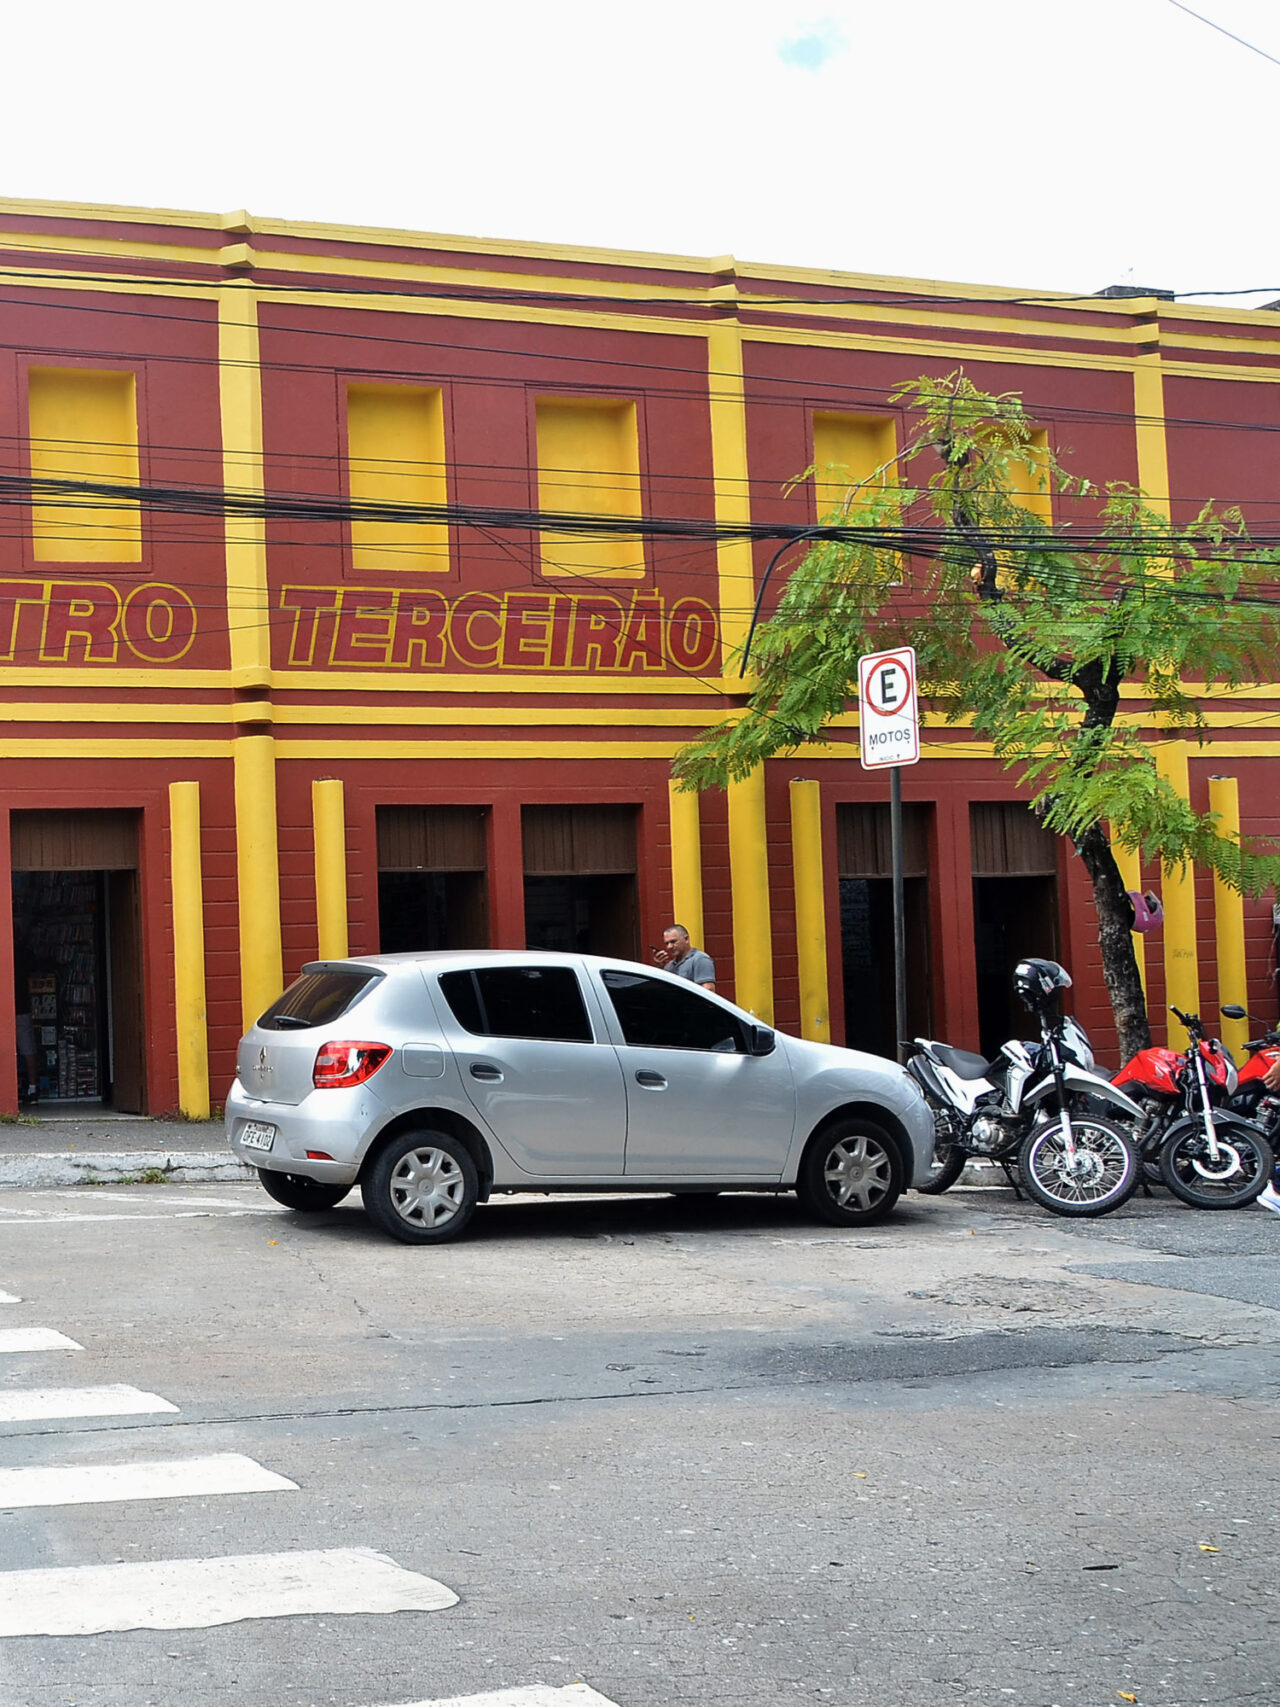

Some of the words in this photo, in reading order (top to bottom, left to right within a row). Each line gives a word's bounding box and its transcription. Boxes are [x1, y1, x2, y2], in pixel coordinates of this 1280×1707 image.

[279, 584, 720, 672] TERCEIRÃO
[880, 668, 897, 704] E
[869, 728, 911, 745] MOTOS
